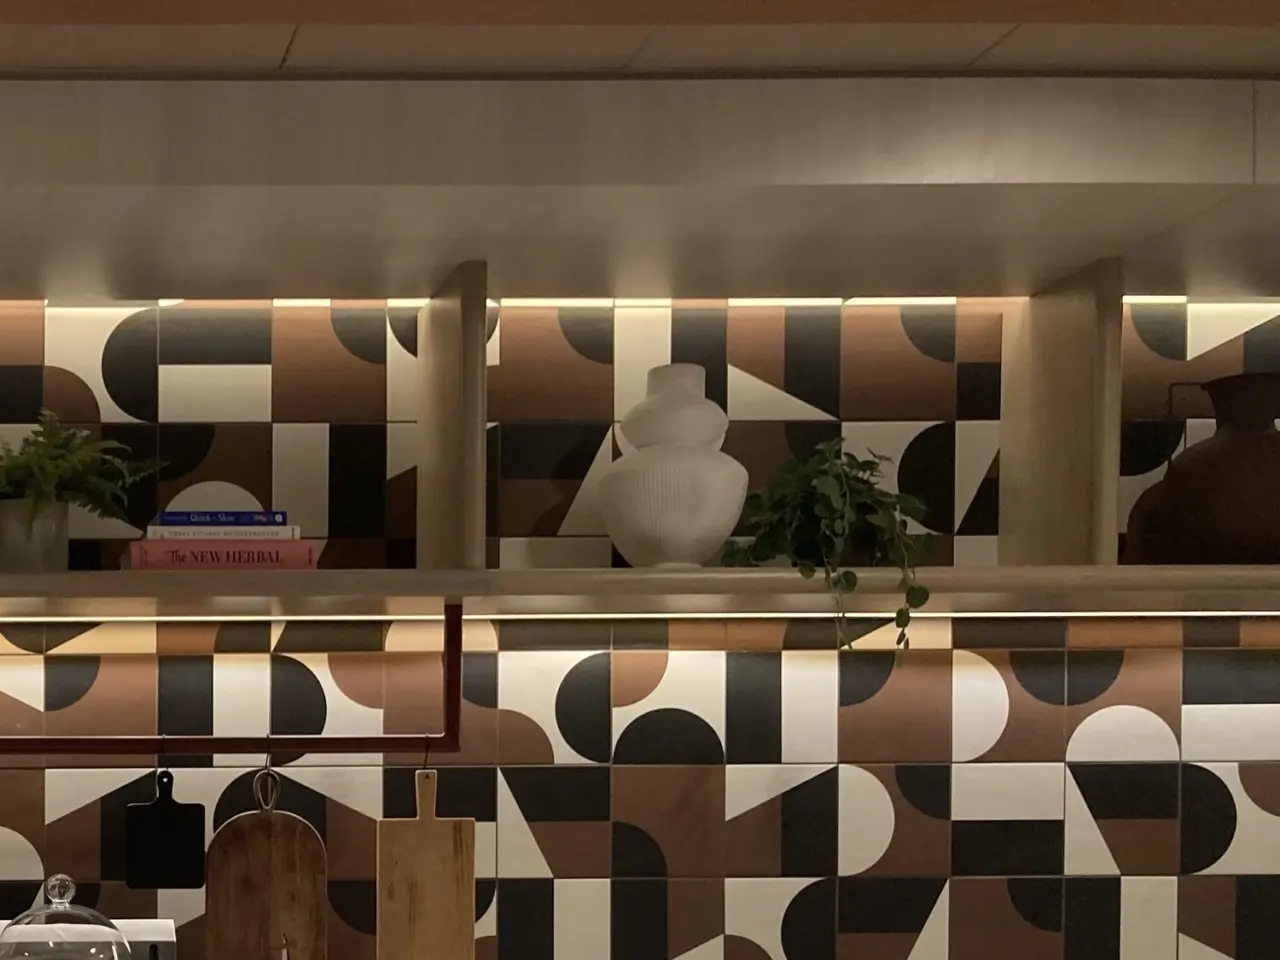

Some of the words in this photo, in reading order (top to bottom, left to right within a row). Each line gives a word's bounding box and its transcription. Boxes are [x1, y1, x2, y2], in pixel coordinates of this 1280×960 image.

[170, 549, 187, 564] The
[190, 550, 220, 564] NEW
[226, 550, 284, 564] HERBAL
